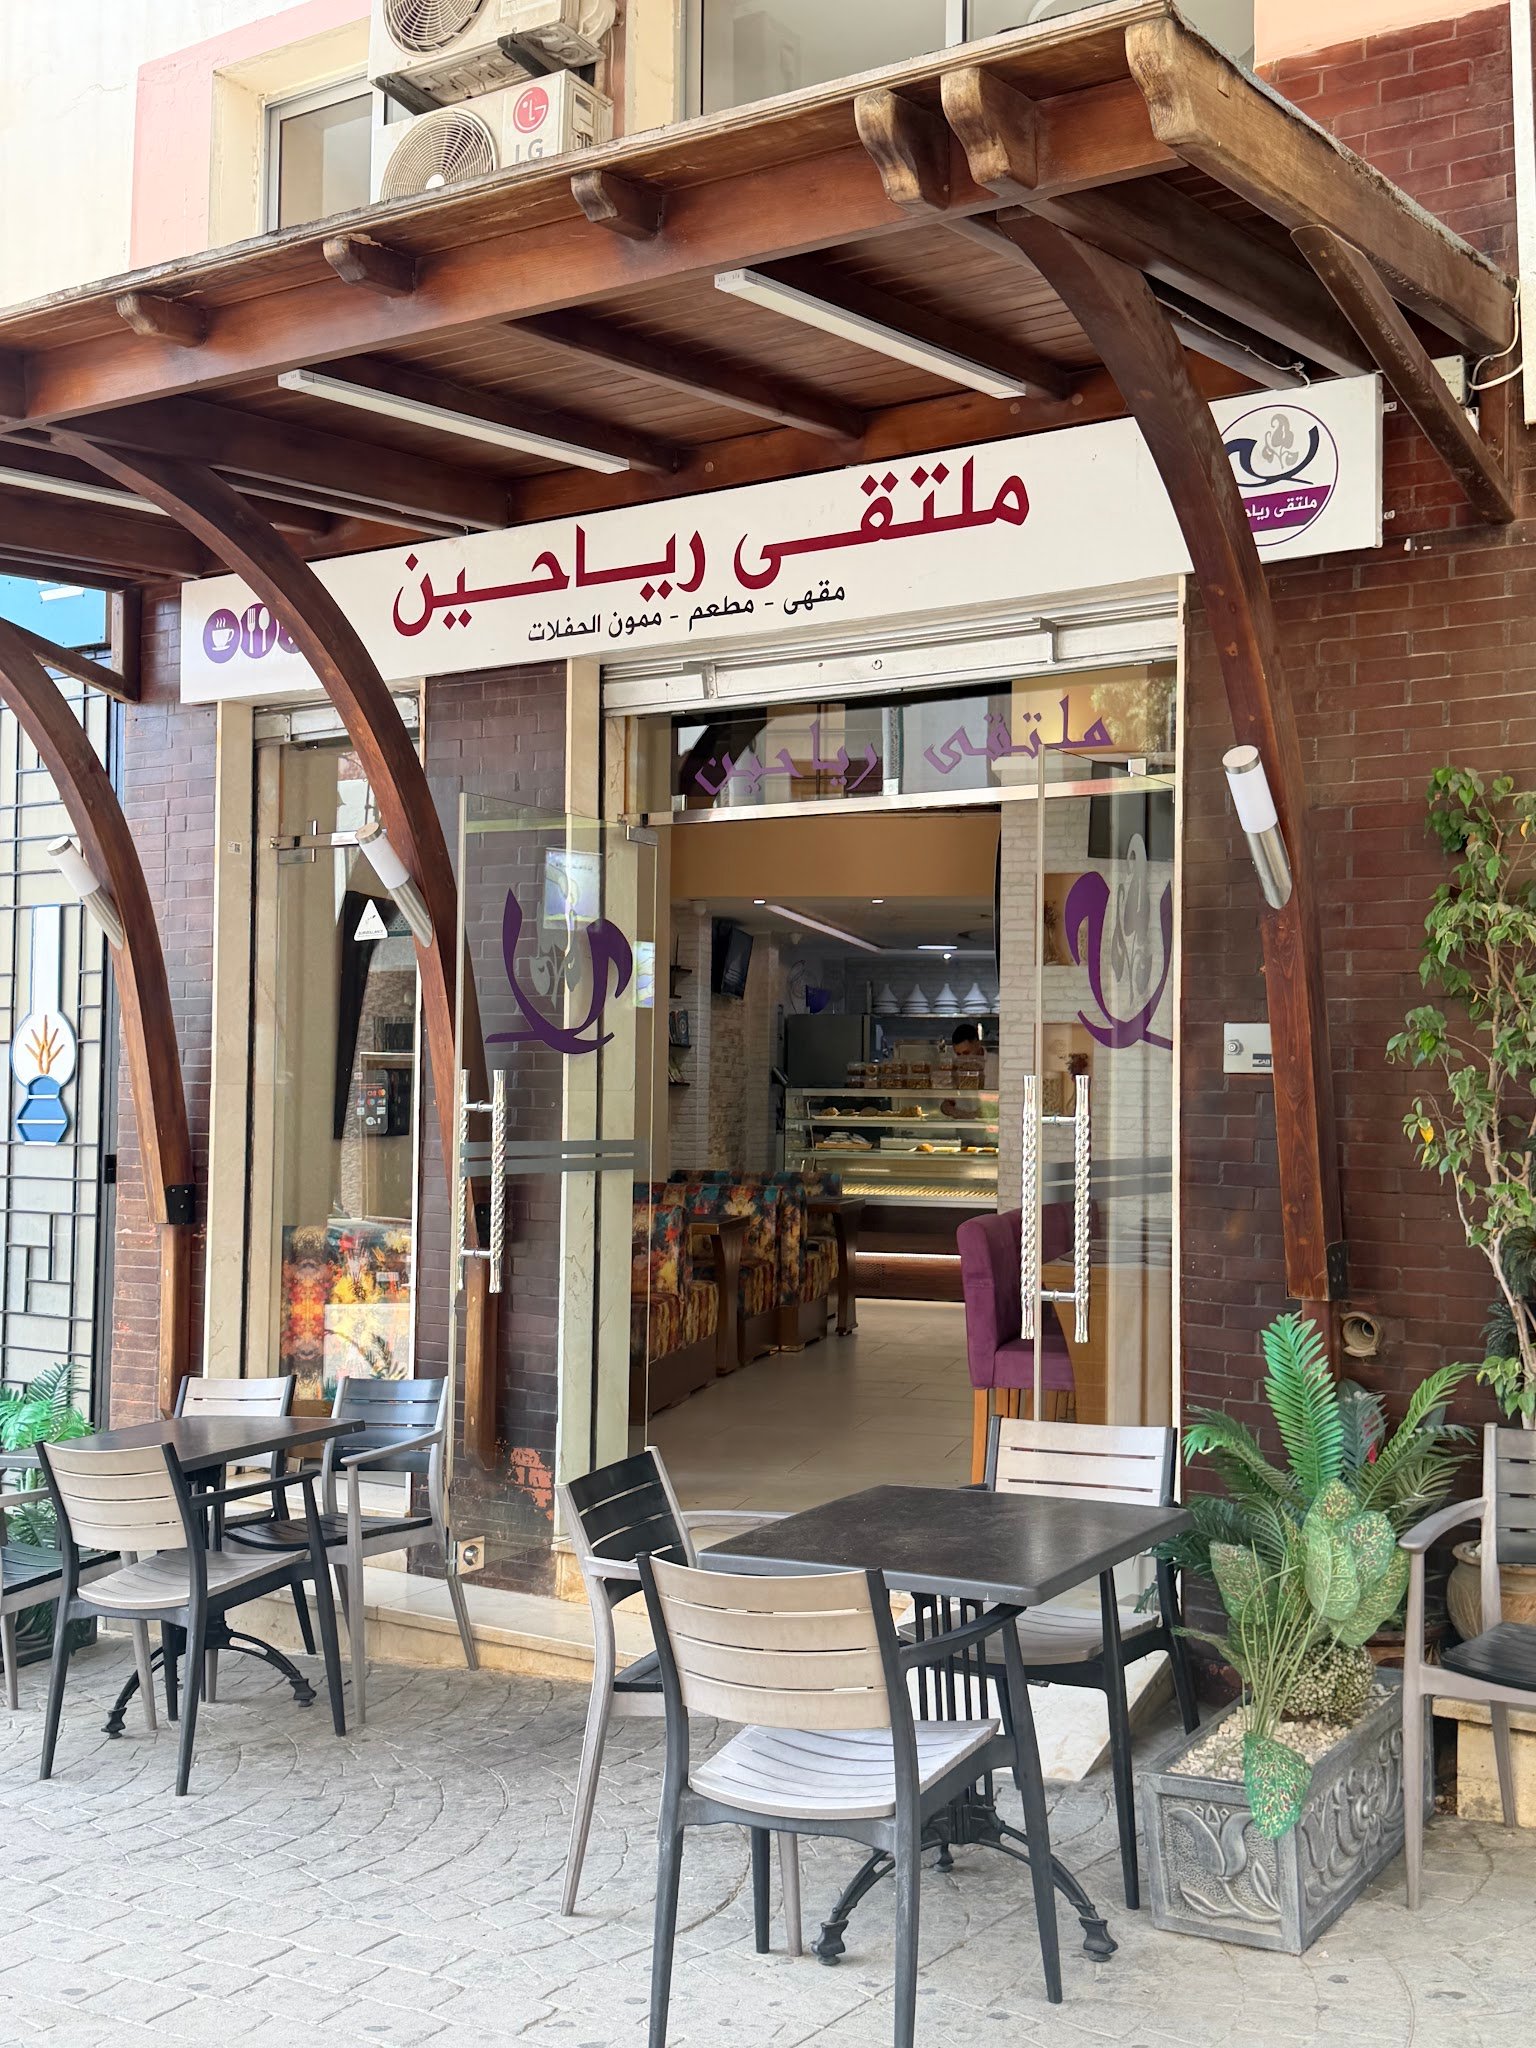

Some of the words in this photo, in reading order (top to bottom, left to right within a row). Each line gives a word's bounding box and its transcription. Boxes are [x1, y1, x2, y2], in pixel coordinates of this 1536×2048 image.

[515, 139, 543, 163] LG
[733, 455, 1030, 590] ملتقى
[1274, 496, 1317, 517] ملتقى
[392, 524, 706, 637] رياحين
[784, 580, 845, 615] مقهى
[529, 614, 601, 642] الحفلات
[609, 612, 662, 638] ممون
[689, 596, 754, 632] مطعم
[924, 695, 1114, 774] ملتقى
[695, 719, 878, 795] رياحين
